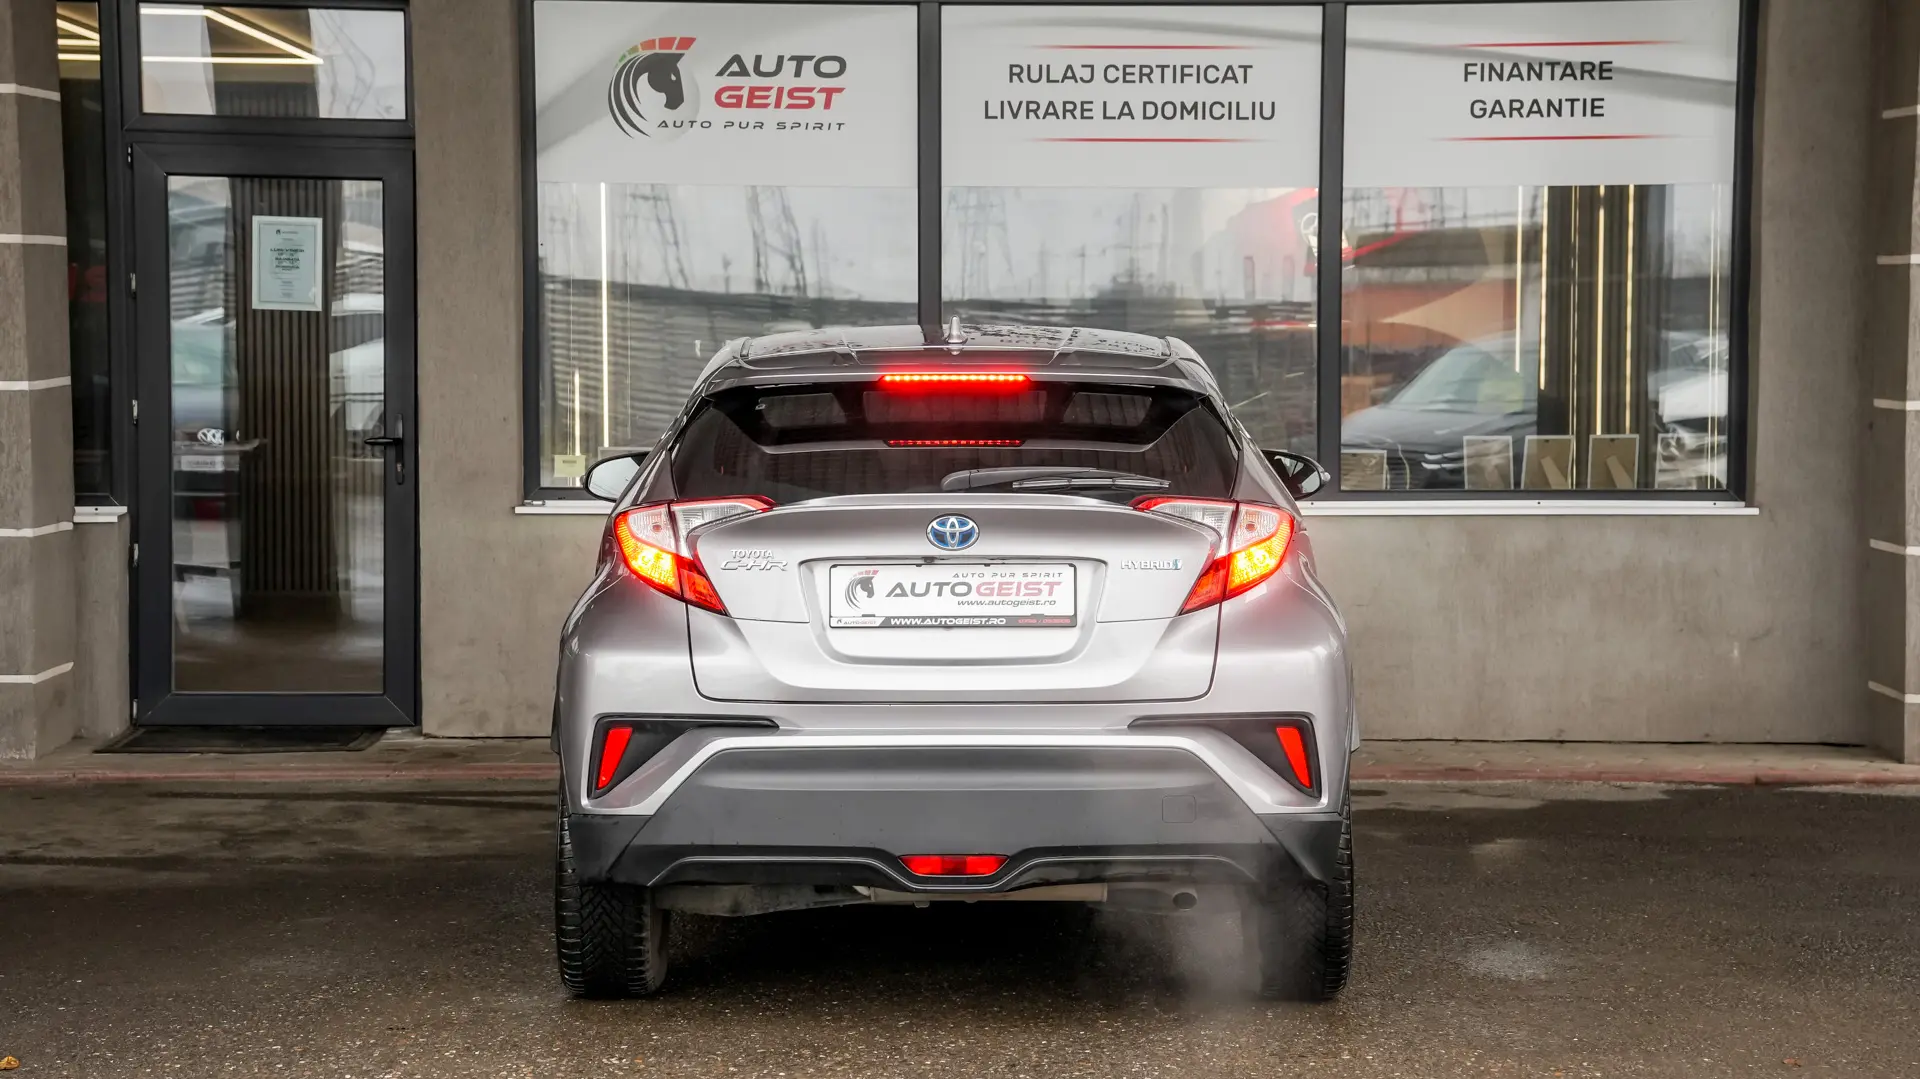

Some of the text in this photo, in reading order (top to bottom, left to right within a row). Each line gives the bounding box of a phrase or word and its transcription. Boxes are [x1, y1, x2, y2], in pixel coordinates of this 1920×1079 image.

[715, 54, 847, 78] AUTO
[1463, 61, 1613, 82] FINANTARE
[1008, 64, 1253, 84] RULAJ CERTIFICAT
[714, 86, 846, 110] GEIST
[984, 100, 1276, 121] LIVRARE LA DOMICILIU
[1470, 98, 1605, 119] GARANTIE
[657, 120, 846, 131] AUTO PUR SPIRIT
[731, 549, 775, 559] TOYOTA
[720, 560, 788, 571] C-HR
[1121, 560, 1173, 570] HYBRID
[957, 599, 1056, 608] www.autogeist.ro
[890, 617, 1007, 626] WWW.AUTOGEIST.RO
